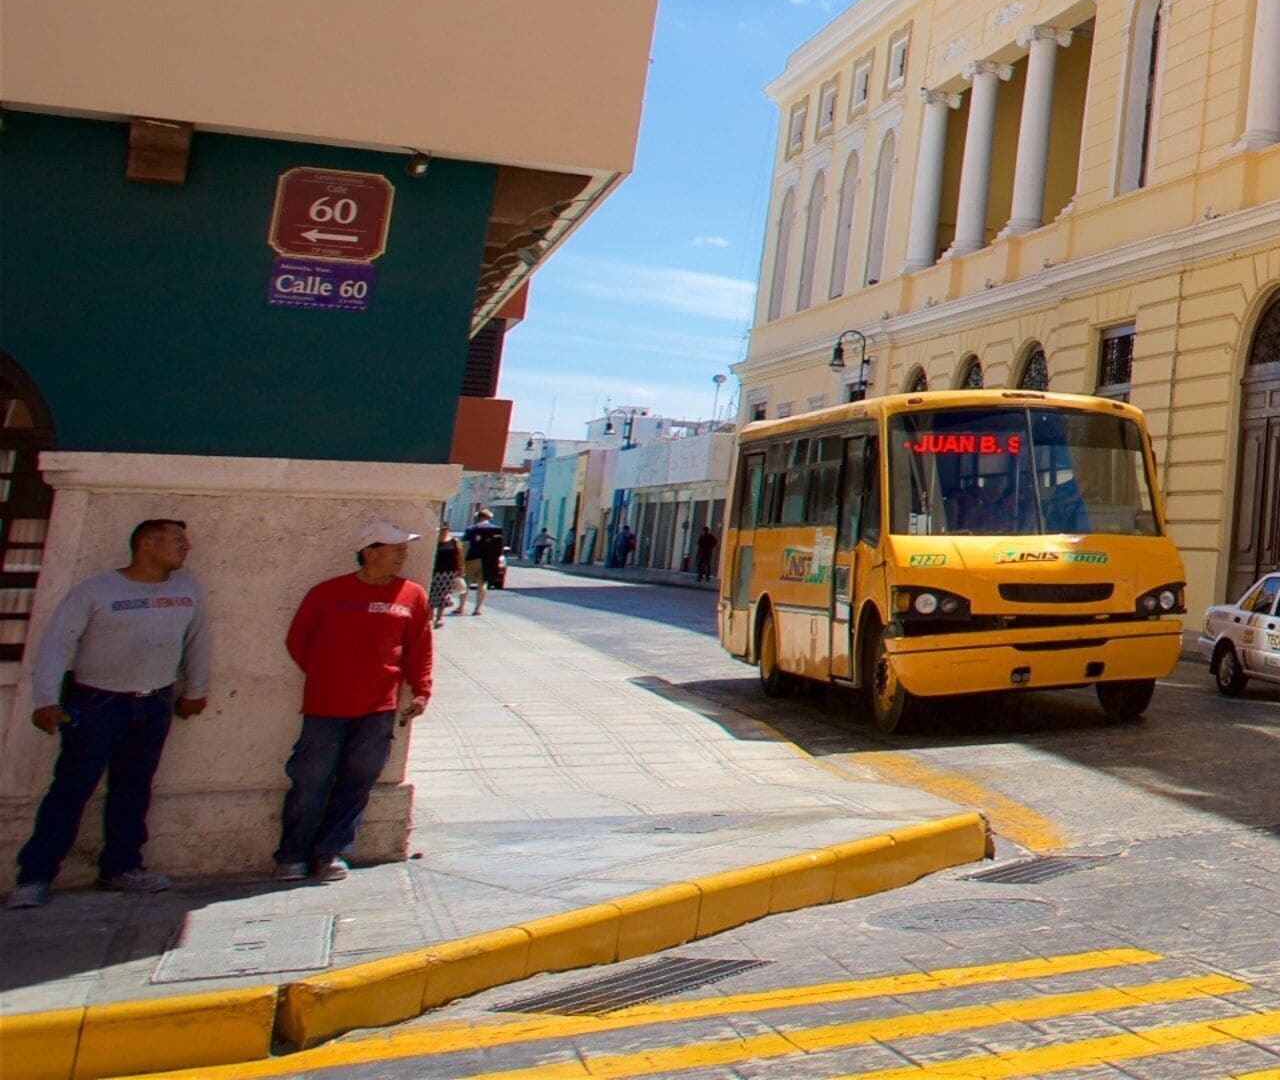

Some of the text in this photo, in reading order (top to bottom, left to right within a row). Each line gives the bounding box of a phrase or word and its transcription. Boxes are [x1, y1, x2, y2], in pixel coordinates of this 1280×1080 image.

[309, 197, 357, 224] 60
[276, 275, 367, 299] Calle 60
[913, 434, 975, 453] JUAN
[980, 434, 1003, 453] B.
